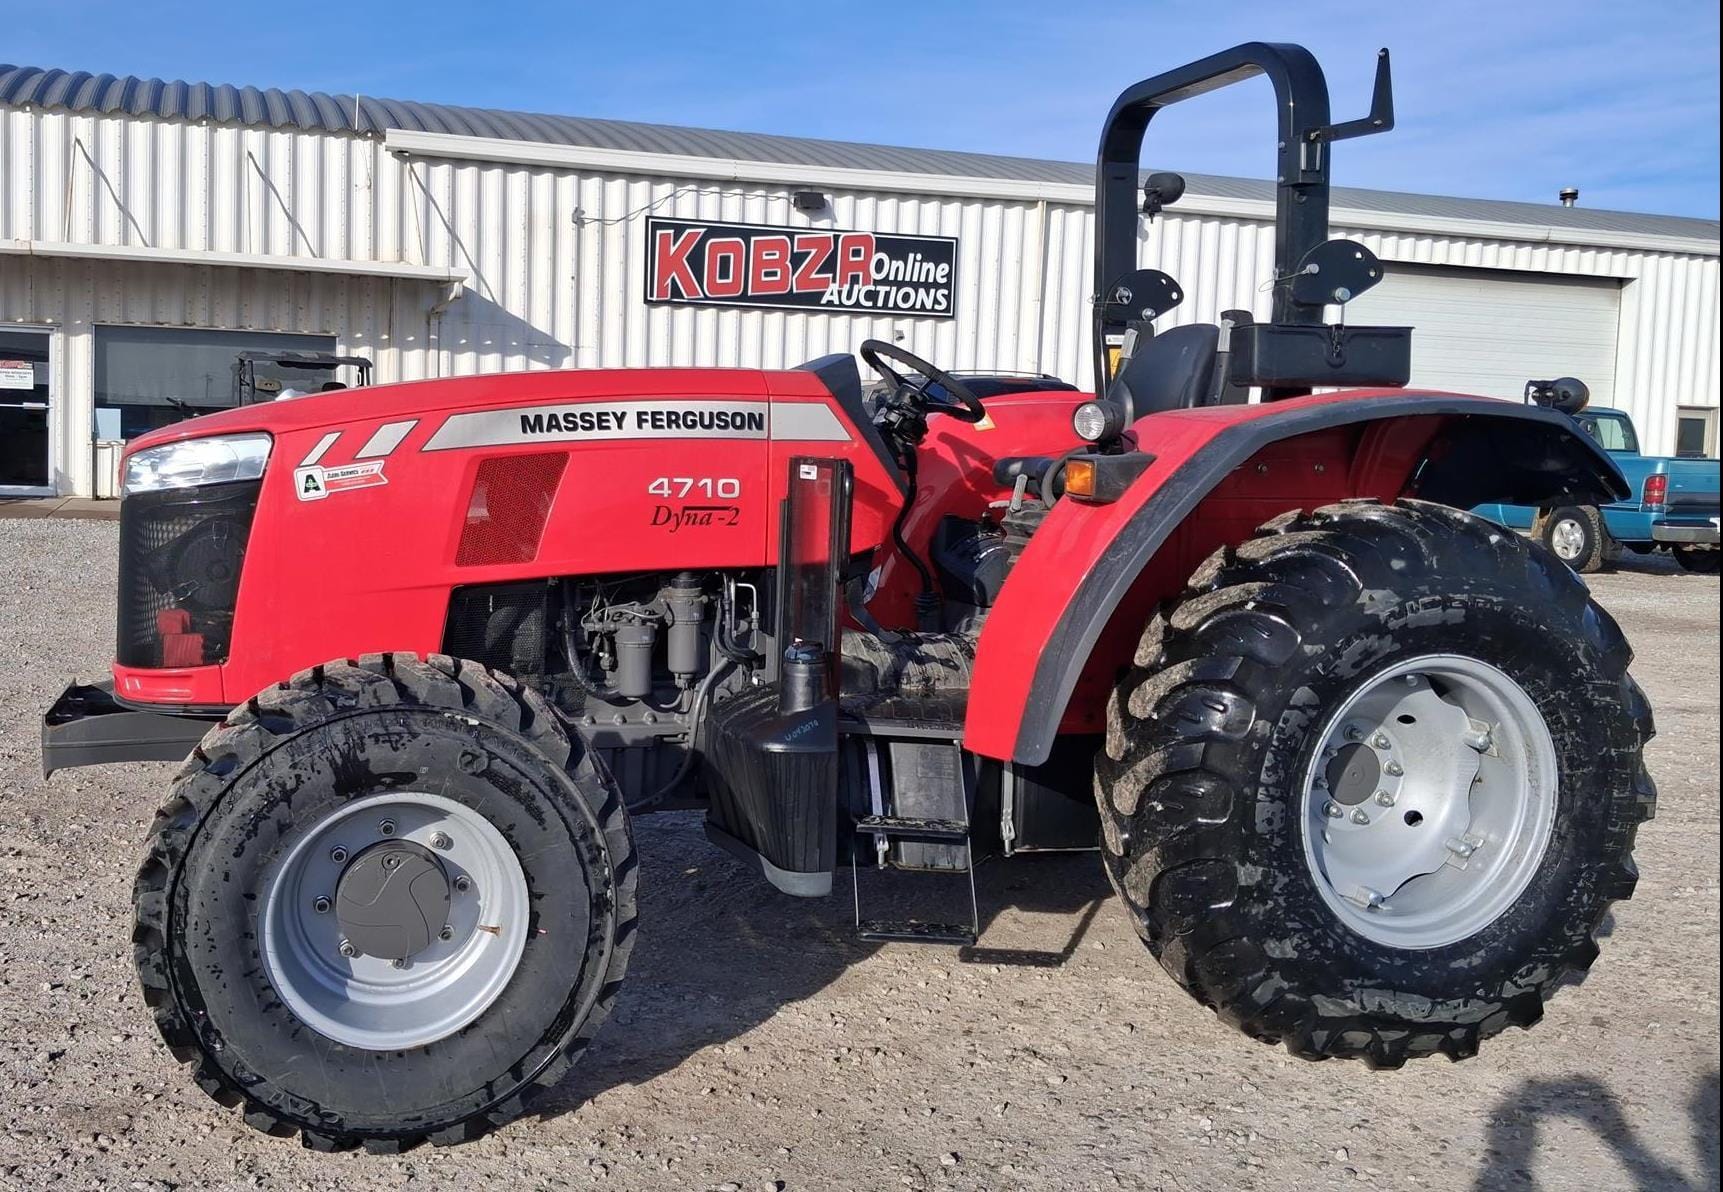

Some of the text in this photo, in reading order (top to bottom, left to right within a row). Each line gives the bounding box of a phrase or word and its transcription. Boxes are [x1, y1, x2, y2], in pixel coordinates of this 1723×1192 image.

[654, 227, 950, 301] KOBZA Online
[820, 283, 949, 311] AUCTIONS
[520, 410, 765, 434] MASSEY FERGUSON
[648, 477, 741, 499] 4710
